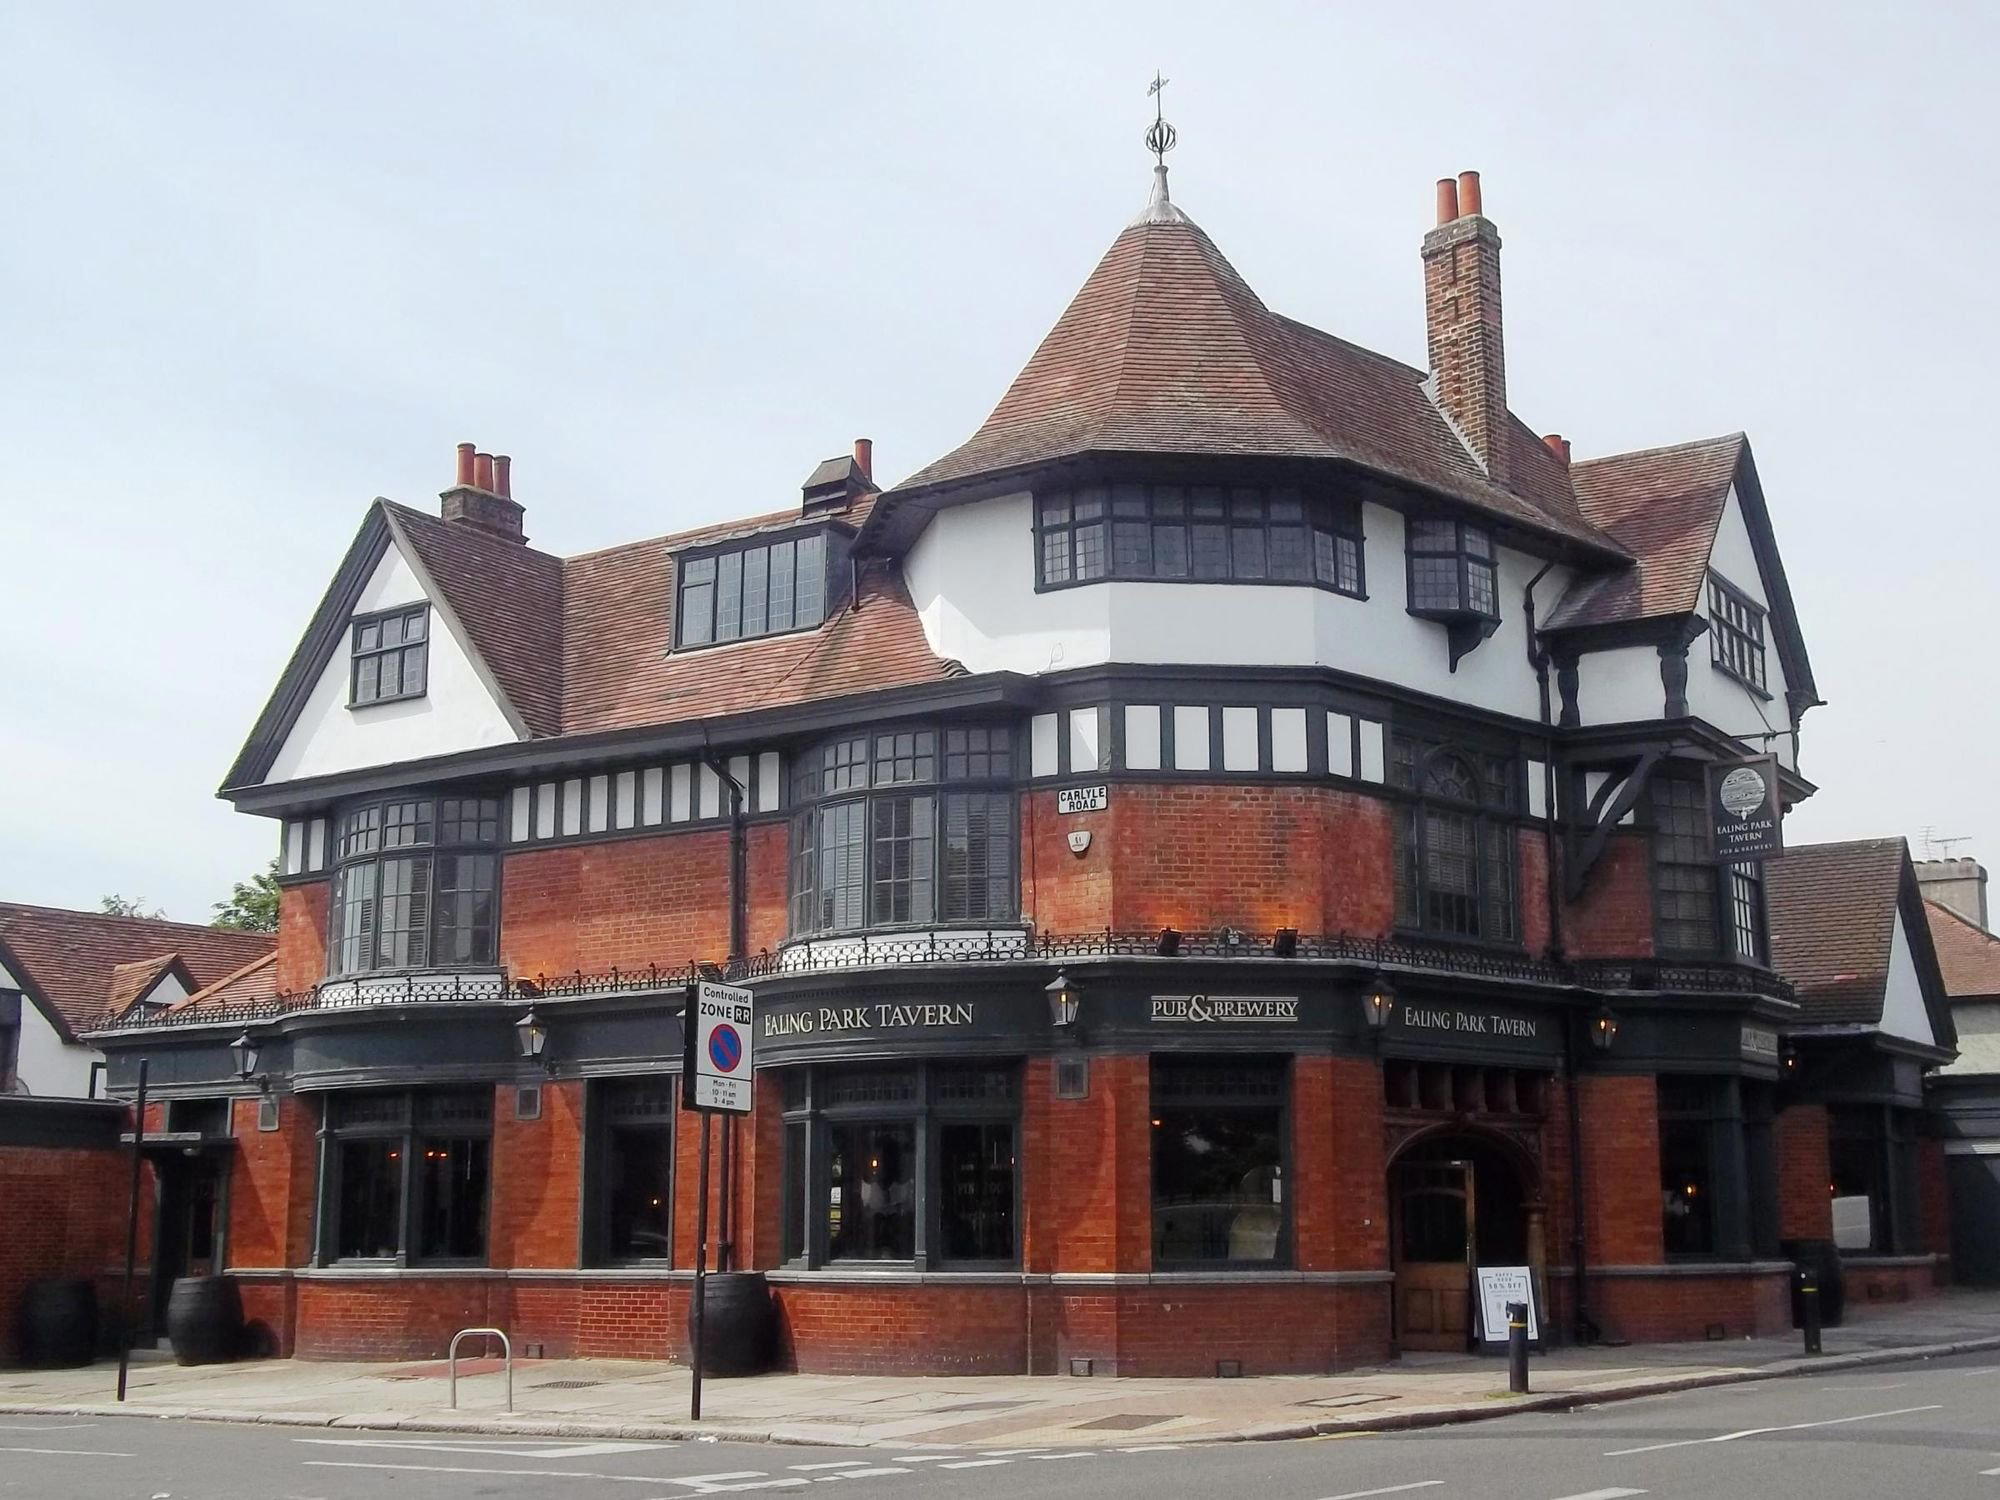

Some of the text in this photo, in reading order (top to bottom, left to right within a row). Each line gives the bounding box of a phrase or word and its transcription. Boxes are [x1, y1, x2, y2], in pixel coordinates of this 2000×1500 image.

[1060, 787, 1105, 802] CARLYLE
[1717, 820, 1773, 835] EALING PARK
[1729, 832, 1762, 843] TAVERN
[704, 987, 749, 1003] Controlled
[700, 1003, 750, 1022] ZONE RR
[764, 1003, 974, 1037] EALING PARK TAVERN
[1404, 1007, 1536, 1037] EALING PARK TAVERN
[728, 1081, 737, 1089] Fri
